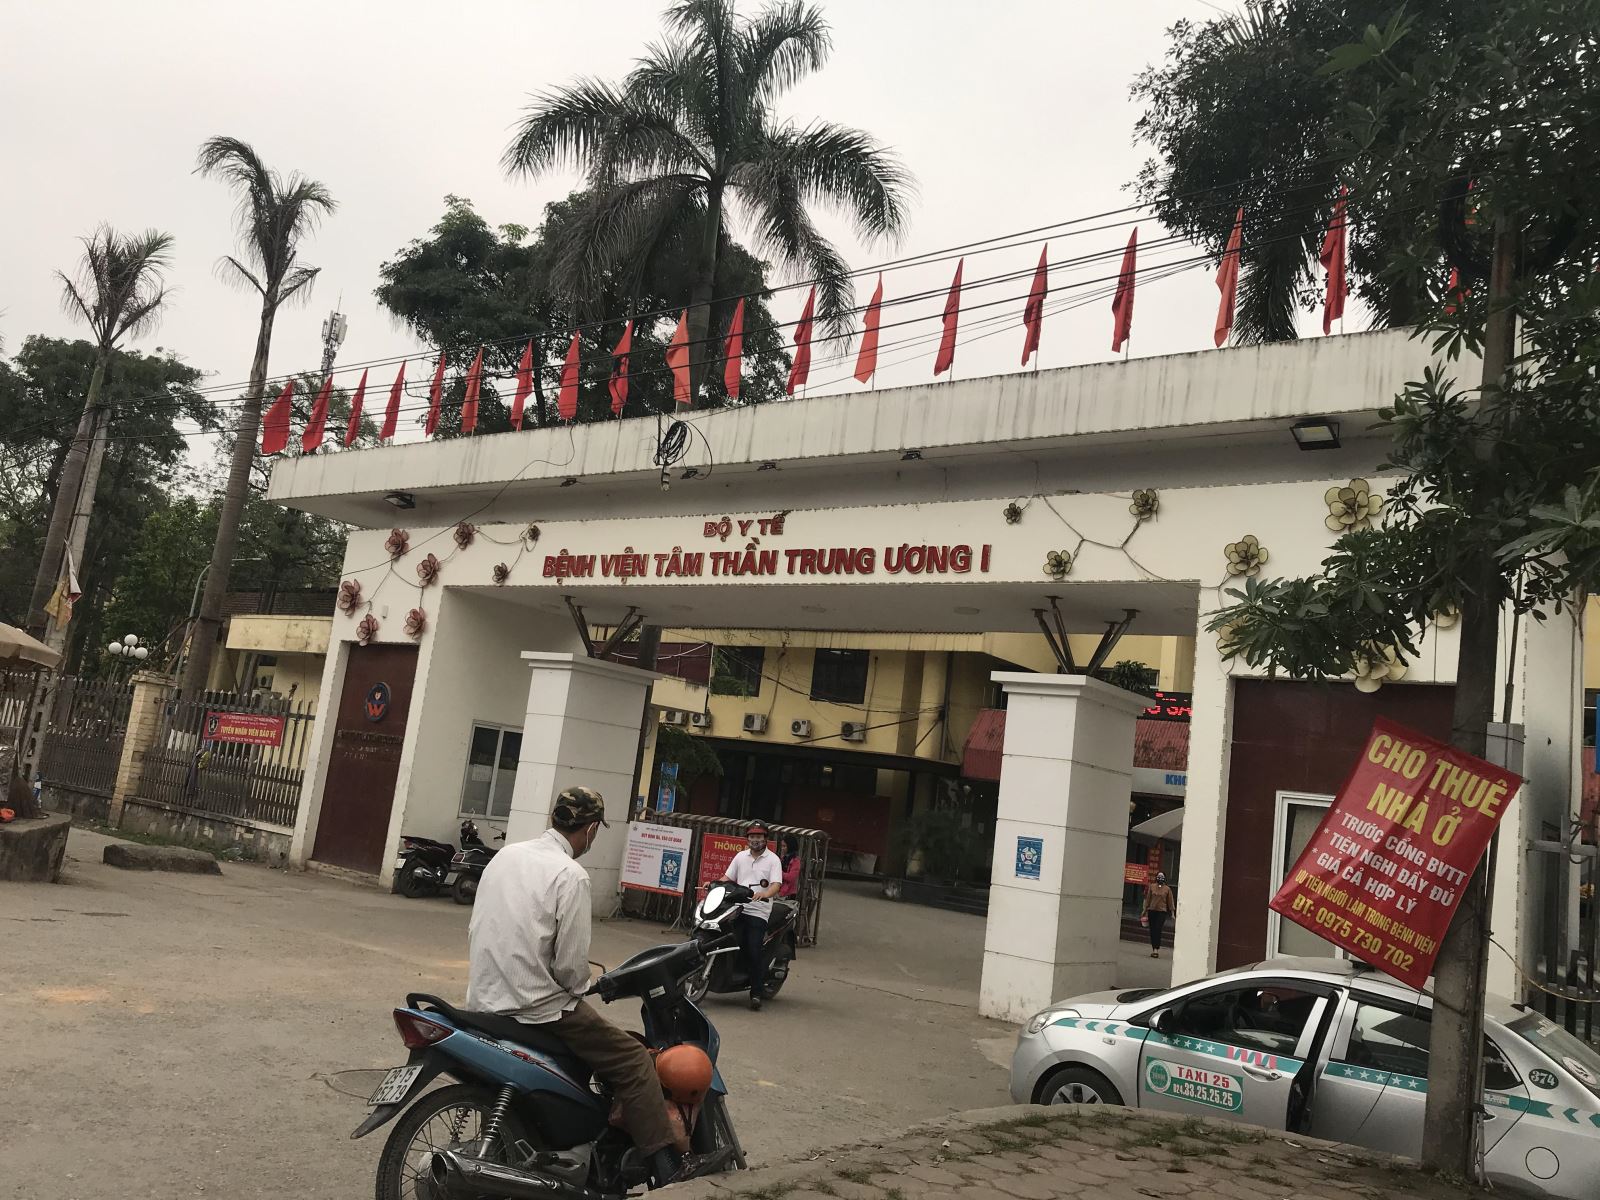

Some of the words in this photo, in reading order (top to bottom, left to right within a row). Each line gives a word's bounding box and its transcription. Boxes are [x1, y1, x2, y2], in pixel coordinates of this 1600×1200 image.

[703, 516, 732, 542] BỘ
[738, 519, 753, 537] Y
[758, 513, 785, 536] TẾ
[542, 548, 596, 585] BỆNH
[600, 547, 648, 585] VIỆN
[653, 546, 703, 577] TÂM
[709, 537, 778, 576] THẦN
[785, 548, 875, 575] TRUNG
[884, 541, 972, 575] ƯƠNG
[980, 544, 992, 573] I
[1367, 734, 1427, 780] CHO
[1428, 758, 1508, 819] THUÊ
[1366, 782, 1430, 835] NHÀ
[1431, 806, 1462, 846] Ở
[714, 841, 743, 852] THÔNG
[1329, 831, 1360, 858] TIỆN
[1360, 849, 1397, 877] NGHI
[1396, 867, 1428, 894] ĐẦY
[1429, 885, 1456, 907] ĐỦ
[1341, 812, 1384, 844] TRƯỚC
[1385, 836, 1426, 866] CỔNG
[1426, 857, 1468, 886] BVTT
[1316, 852, 1341, 875] GIÁ
[1341, 865, 1363, 886] CẢ
[1364, 877, 1396, 901] HỢP
[1395, 894, 1417, 914] LÝ
[1292, 893, 1315, 917] ĐT:
[1315, 907, 1353, 938] 0975
[1352, 927, 1383, 954] 730
[1383, 943, 1414, 972] 702
[1322, 883, 1348, 908] NGƯỜI
[1346, 896, 1366, 917] LÀM
[1364, 907, 1392, 932] TRONG
[1389, 921, 1415, 944] BỆNH
[1413, 934, 1437, 955] VIỆN
[1173, 1082, 1233, 1107] 024.33.25.25.25
[1177, 1066, 1208, 1083] TAXI
[1213, 1075, 1231, 1089] 25
[1531, 1070, 1556, 1087] 374
